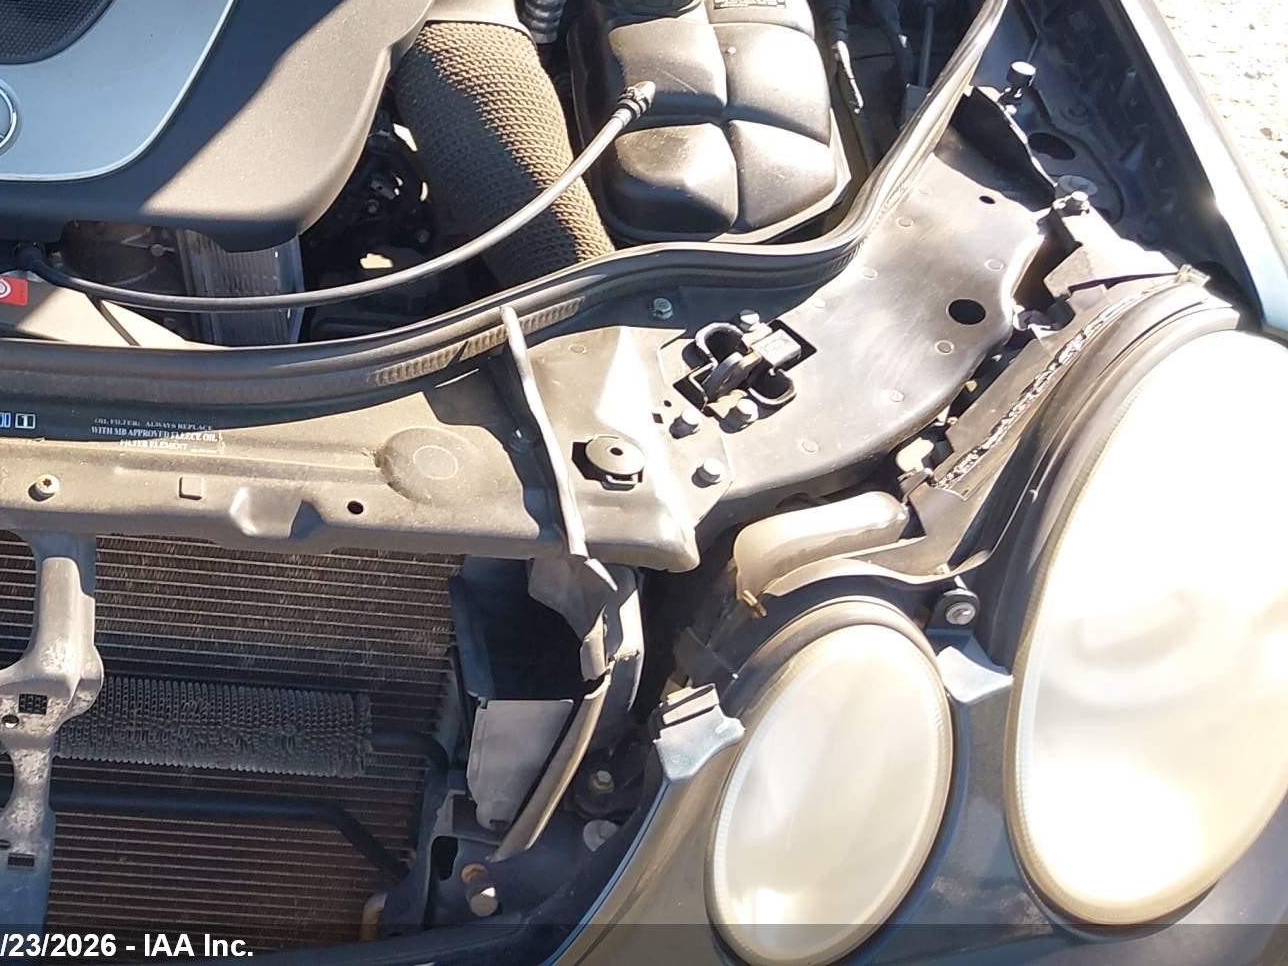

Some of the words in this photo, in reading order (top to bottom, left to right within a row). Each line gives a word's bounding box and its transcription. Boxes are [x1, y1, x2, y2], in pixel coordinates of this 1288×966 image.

[145, 421, 177, 429] ALWAYS
[177, 423, 213, 431] REPLACE
[91, 426, 113, 435] WITH
[203, 433, 218, 443] OIL
